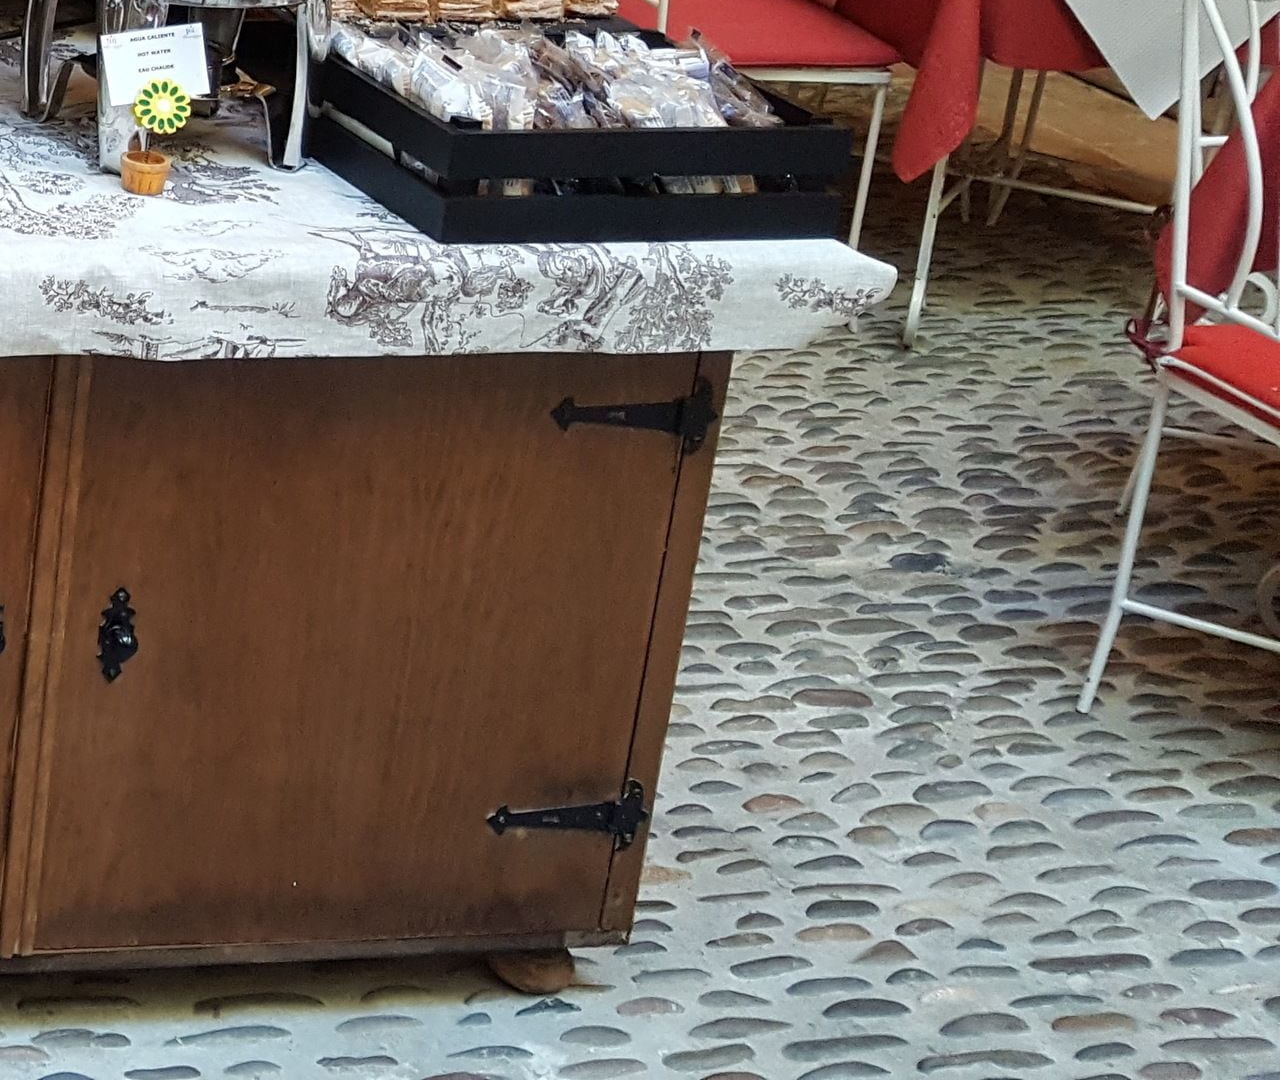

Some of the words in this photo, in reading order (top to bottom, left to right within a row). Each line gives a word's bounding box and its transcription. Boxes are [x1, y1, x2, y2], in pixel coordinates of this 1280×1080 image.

[147, 31, 176, 41] CALIENTE
[151, 48, 172, 56] WATER
[151, 63, 175, 72] CHAUDE
